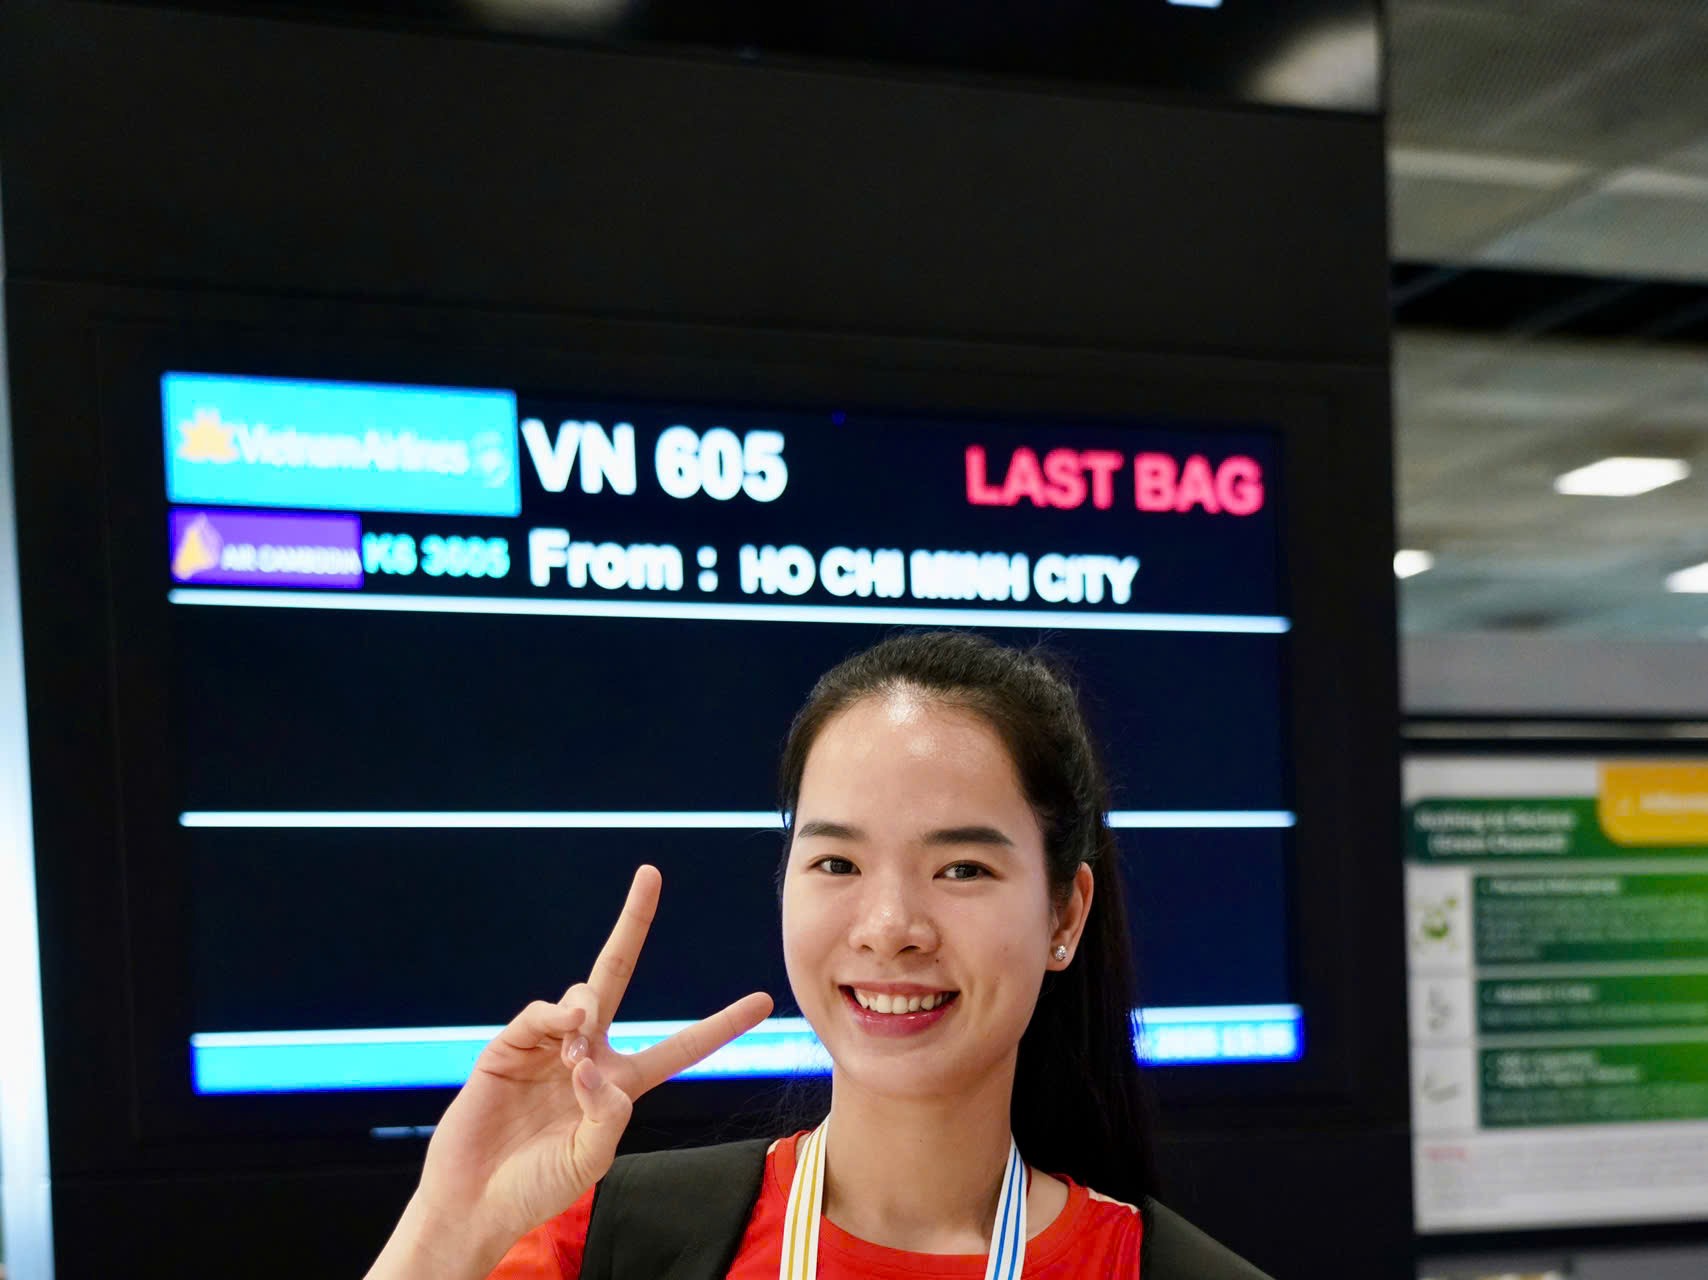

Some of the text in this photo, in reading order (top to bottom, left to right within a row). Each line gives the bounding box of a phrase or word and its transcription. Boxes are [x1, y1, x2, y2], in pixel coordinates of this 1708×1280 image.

[520, 418, 788, 502] VN 605
[965, 444, 1264, 515] LAST BAG
[528, 527, 684, 591] From
[739, 544, 1140, 604] HO CHI MINH CITY
